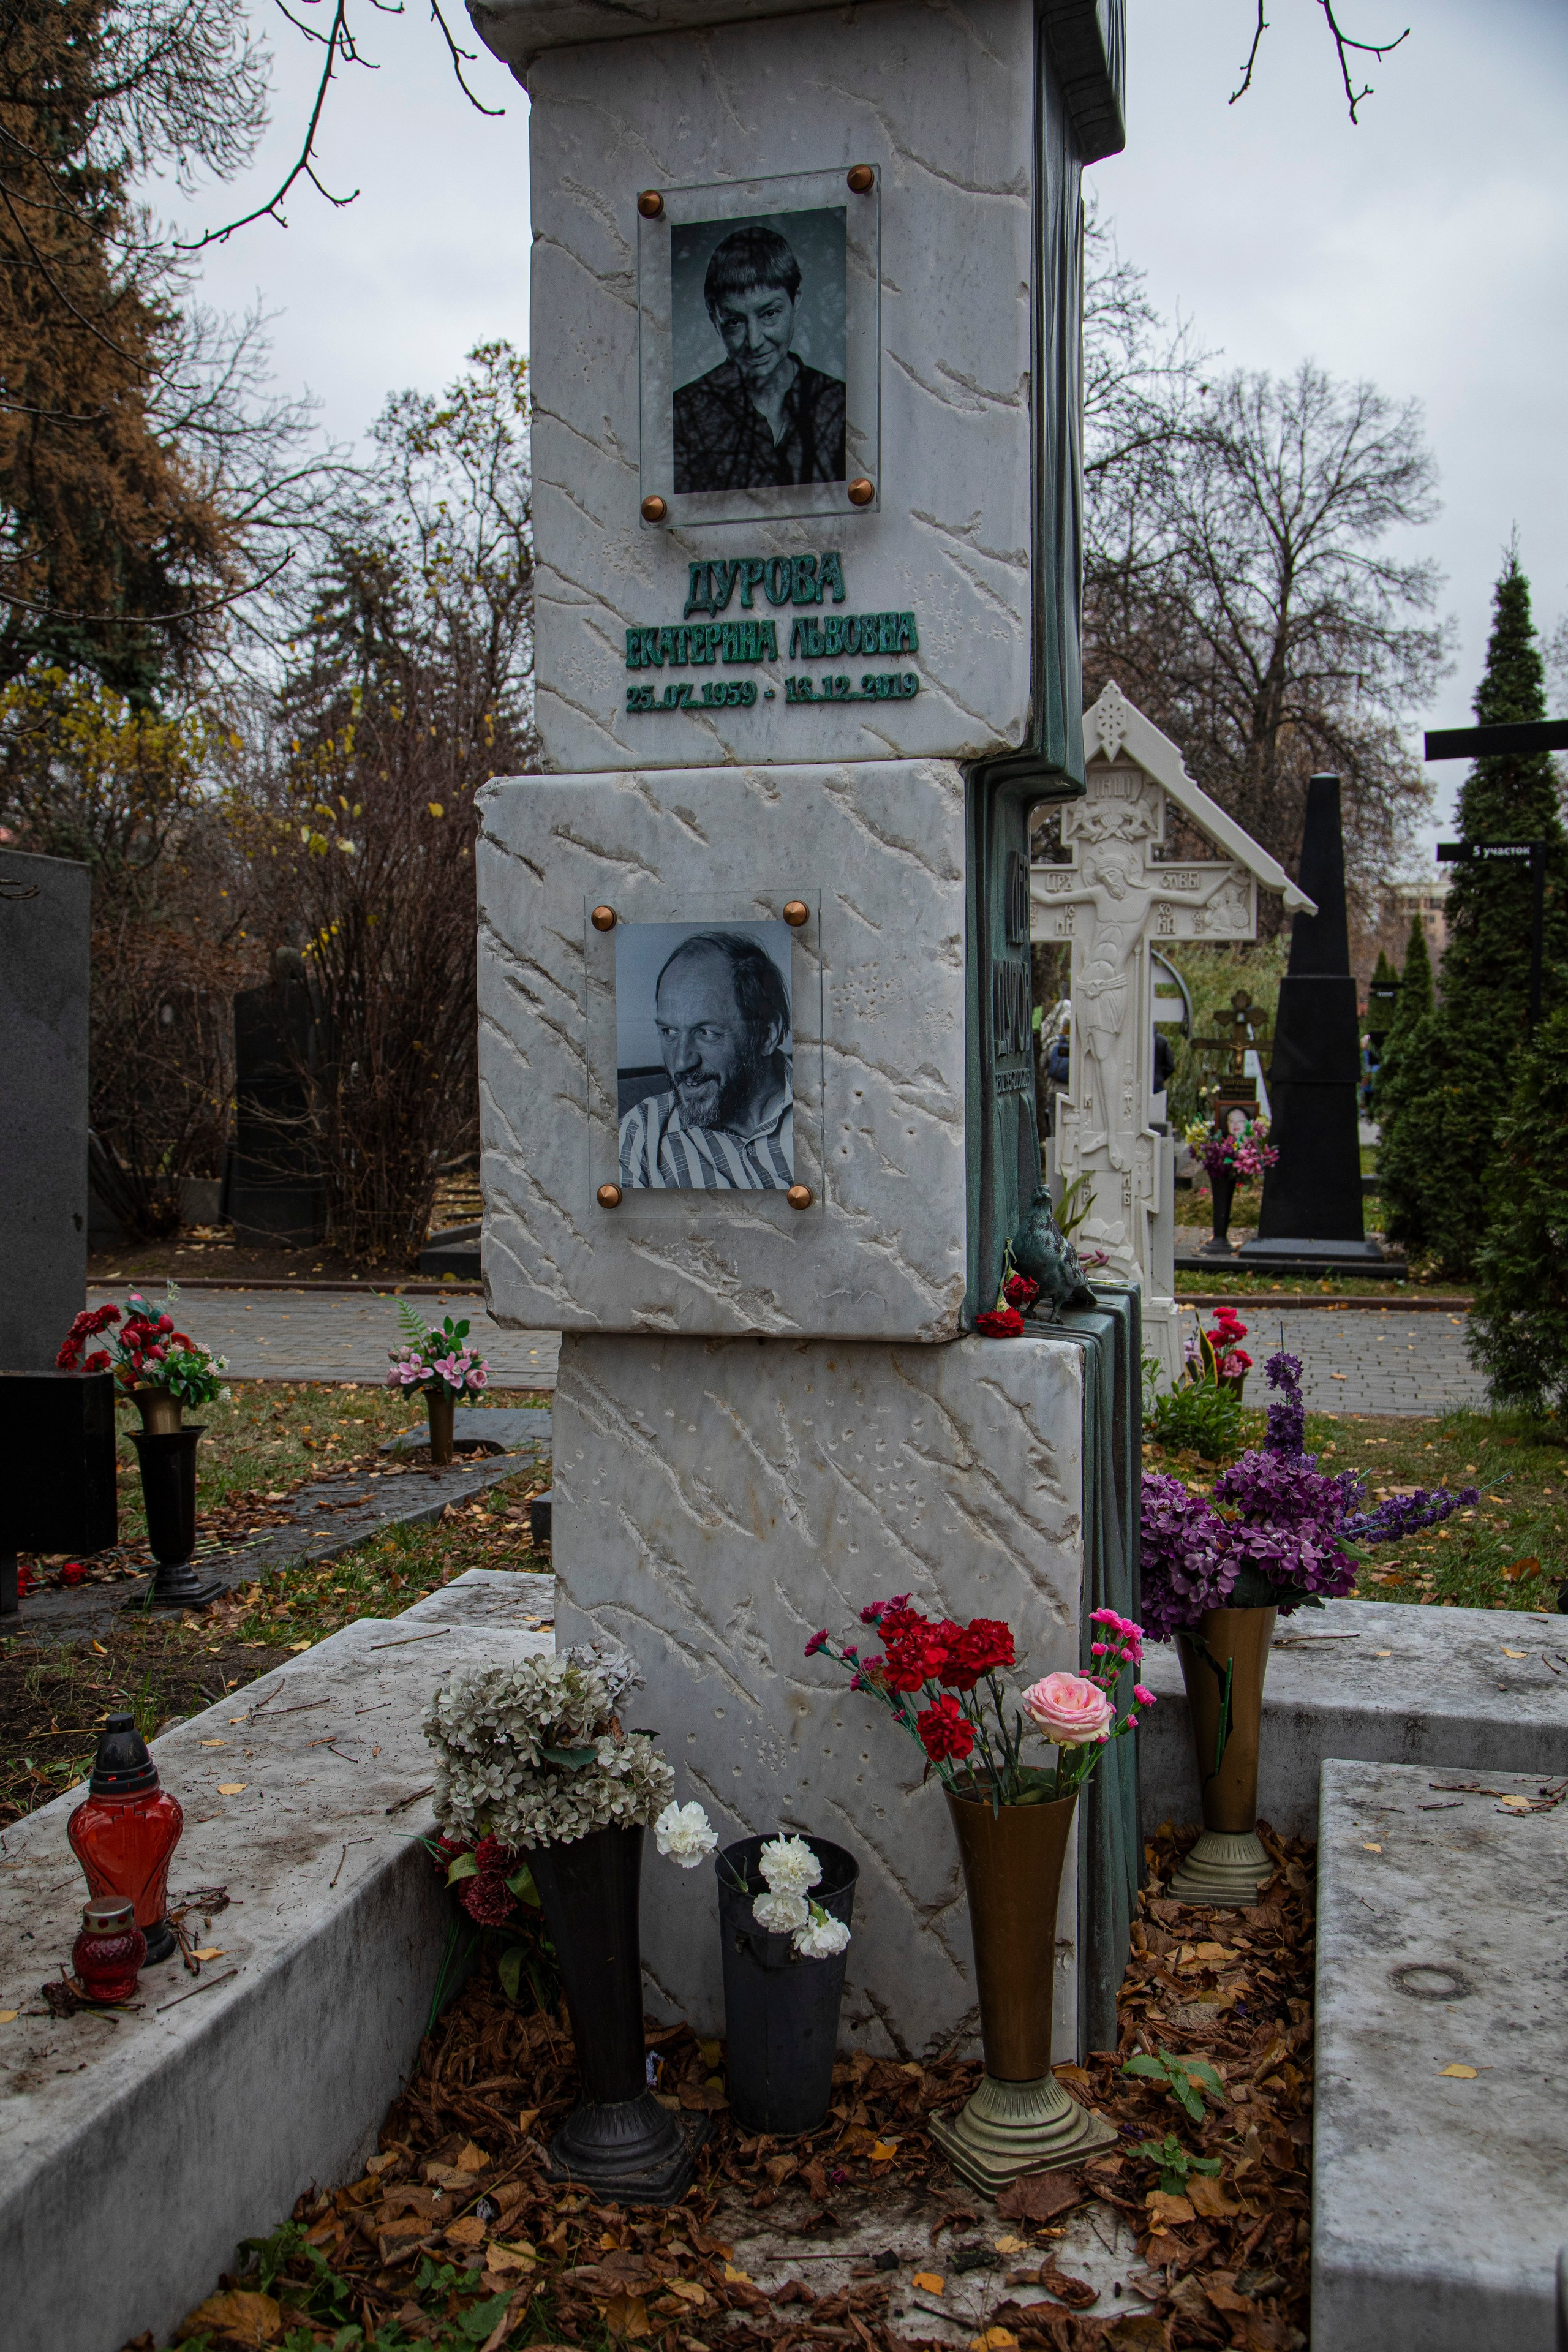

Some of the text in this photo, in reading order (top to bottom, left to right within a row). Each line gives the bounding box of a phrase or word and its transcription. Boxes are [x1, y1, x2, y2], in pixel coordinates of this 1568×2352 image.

[684, 551, 846, 619] ДУРОВА
[625, 611, 919, 668] ЕКАТЕРИНА ЛЬВОВНА
[626, 680, 758, 712] 25.07.1959
[785, 672, 919, 703] 13.12.2019
[1472, 845, 1531, 859] 5 участок
